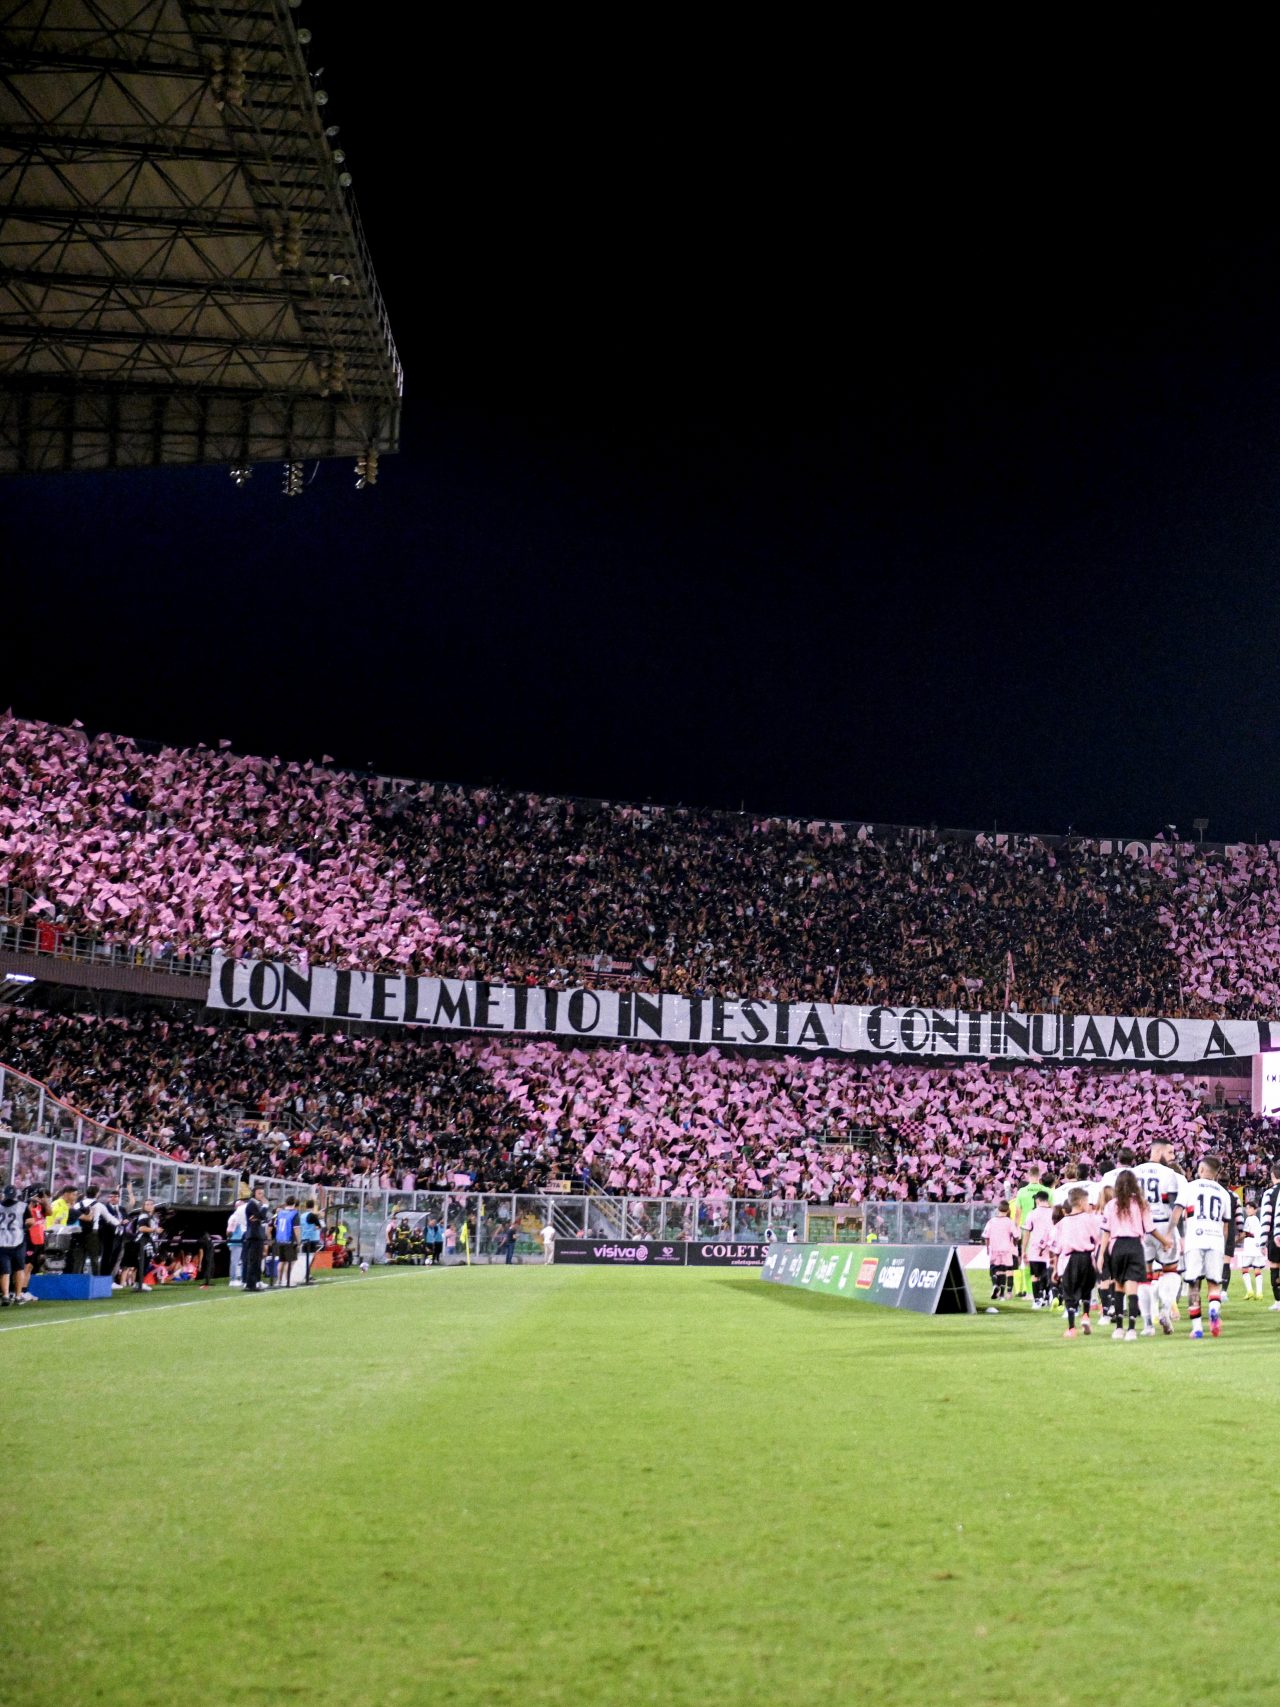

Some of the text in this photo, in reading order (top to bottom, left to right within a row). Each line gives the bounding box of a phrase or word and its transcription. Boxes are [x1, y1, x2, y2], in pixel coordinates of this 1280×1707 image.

[220, 958, 312, 1013] CON
[333, 970, 600, 1033] L'ELMETTO
[617, 992, 663, 1038] IN
[682, 995, 830, 1046] TESTA
[867, 1006, 1180, 1058] CONTINUIAMO
[1203, 1020, 1236, 1058] A
[1197, 1194, 1222, 1221] 10
[593, 1244, 636, 1258] visiva
[701, 1245, 759, 1258] COLET
